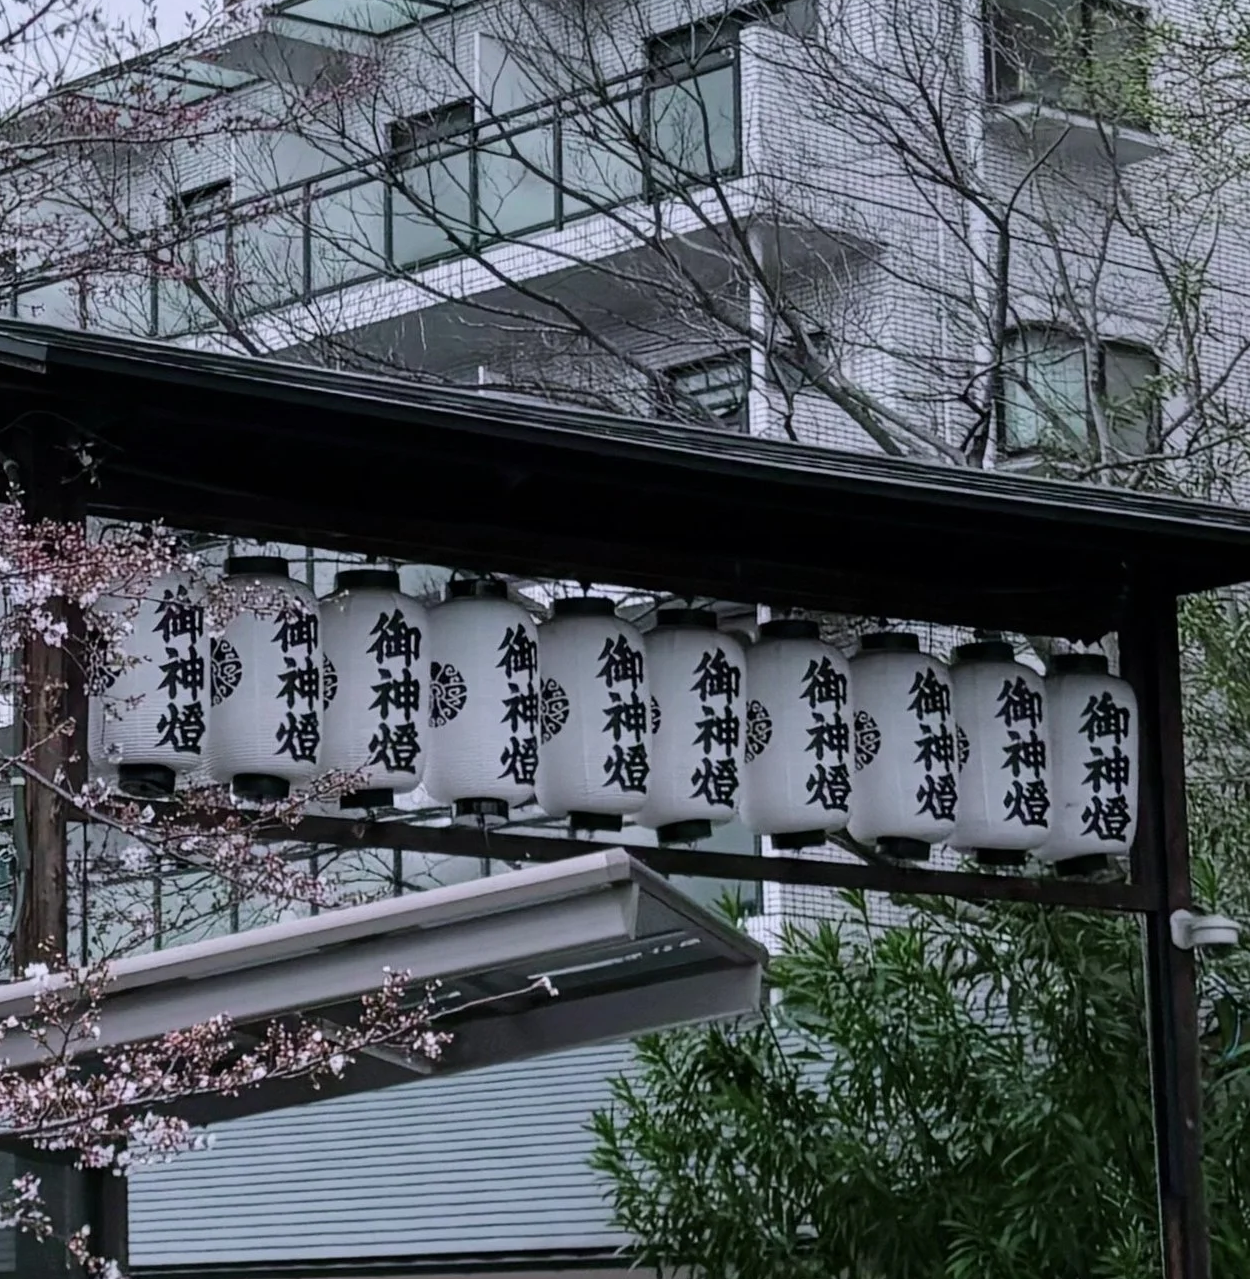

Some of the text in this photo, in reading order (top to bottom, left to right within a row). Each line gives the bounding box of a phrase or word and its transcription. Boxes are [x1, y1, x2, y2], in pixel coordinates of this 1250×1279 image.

[365, 610, 422, 774] 御神燈
[496, 624, 538, 786] 御神燈
[596, 634, 649, 794] 御神燈
[689, 648, 742, 808] 御神燈
[800, 656, 852, 813] 御神燈
[908, 668, 957, 822] 御神燈
[996, 676, 1051, 828] 御神燈
[1078, 691, 1132, 843] 御神燈
